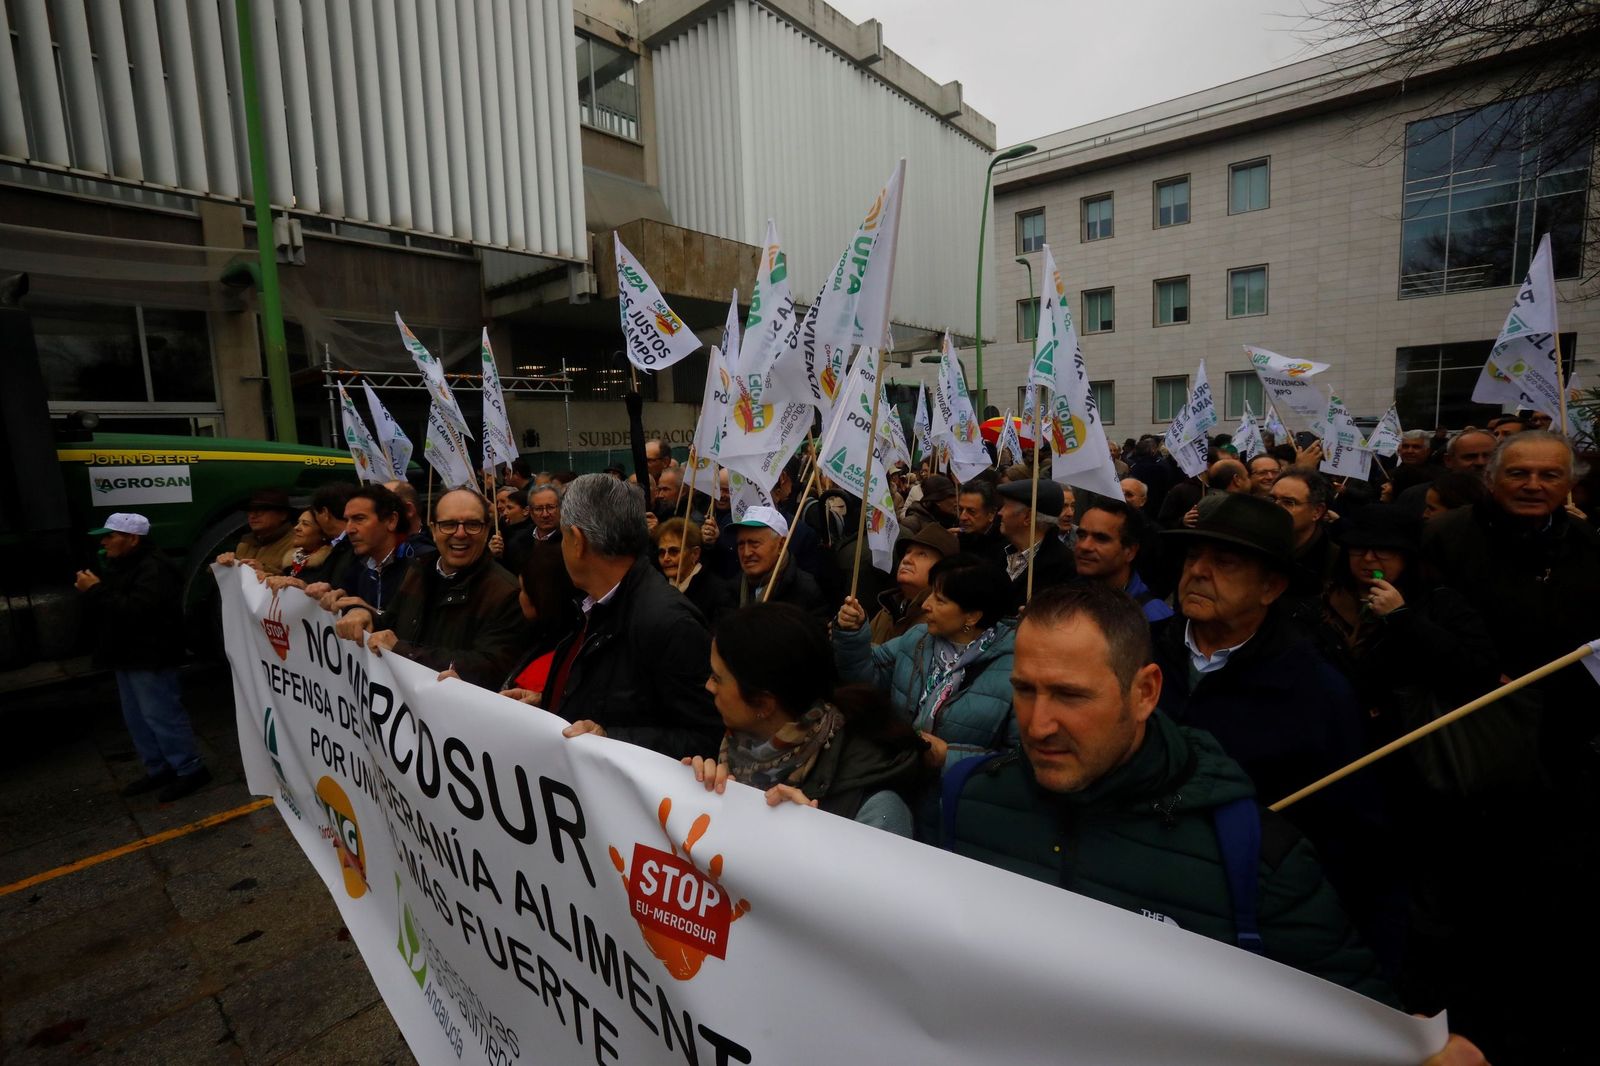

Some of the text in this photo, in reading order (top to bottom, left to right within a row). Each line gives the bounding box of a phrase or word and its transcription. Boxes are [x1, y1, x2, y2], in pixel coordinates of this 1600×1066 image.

[624, 266, 649, 293] UPA
[846, 236, 873, 295] UPA
[629, 310, 671, 359] JUSTOS
[846, 411, 873, 434] POR
[85, 452, 200, 465] JOHN DEERE
[100, 476, 190, 489] AGROSAN
[302, 618, 342, 676] NO
[310, 728, 347, 778] POR
[639, 859, 721, 919] STOP
[636, 899, 718, 945] EU-MERCOSUR
